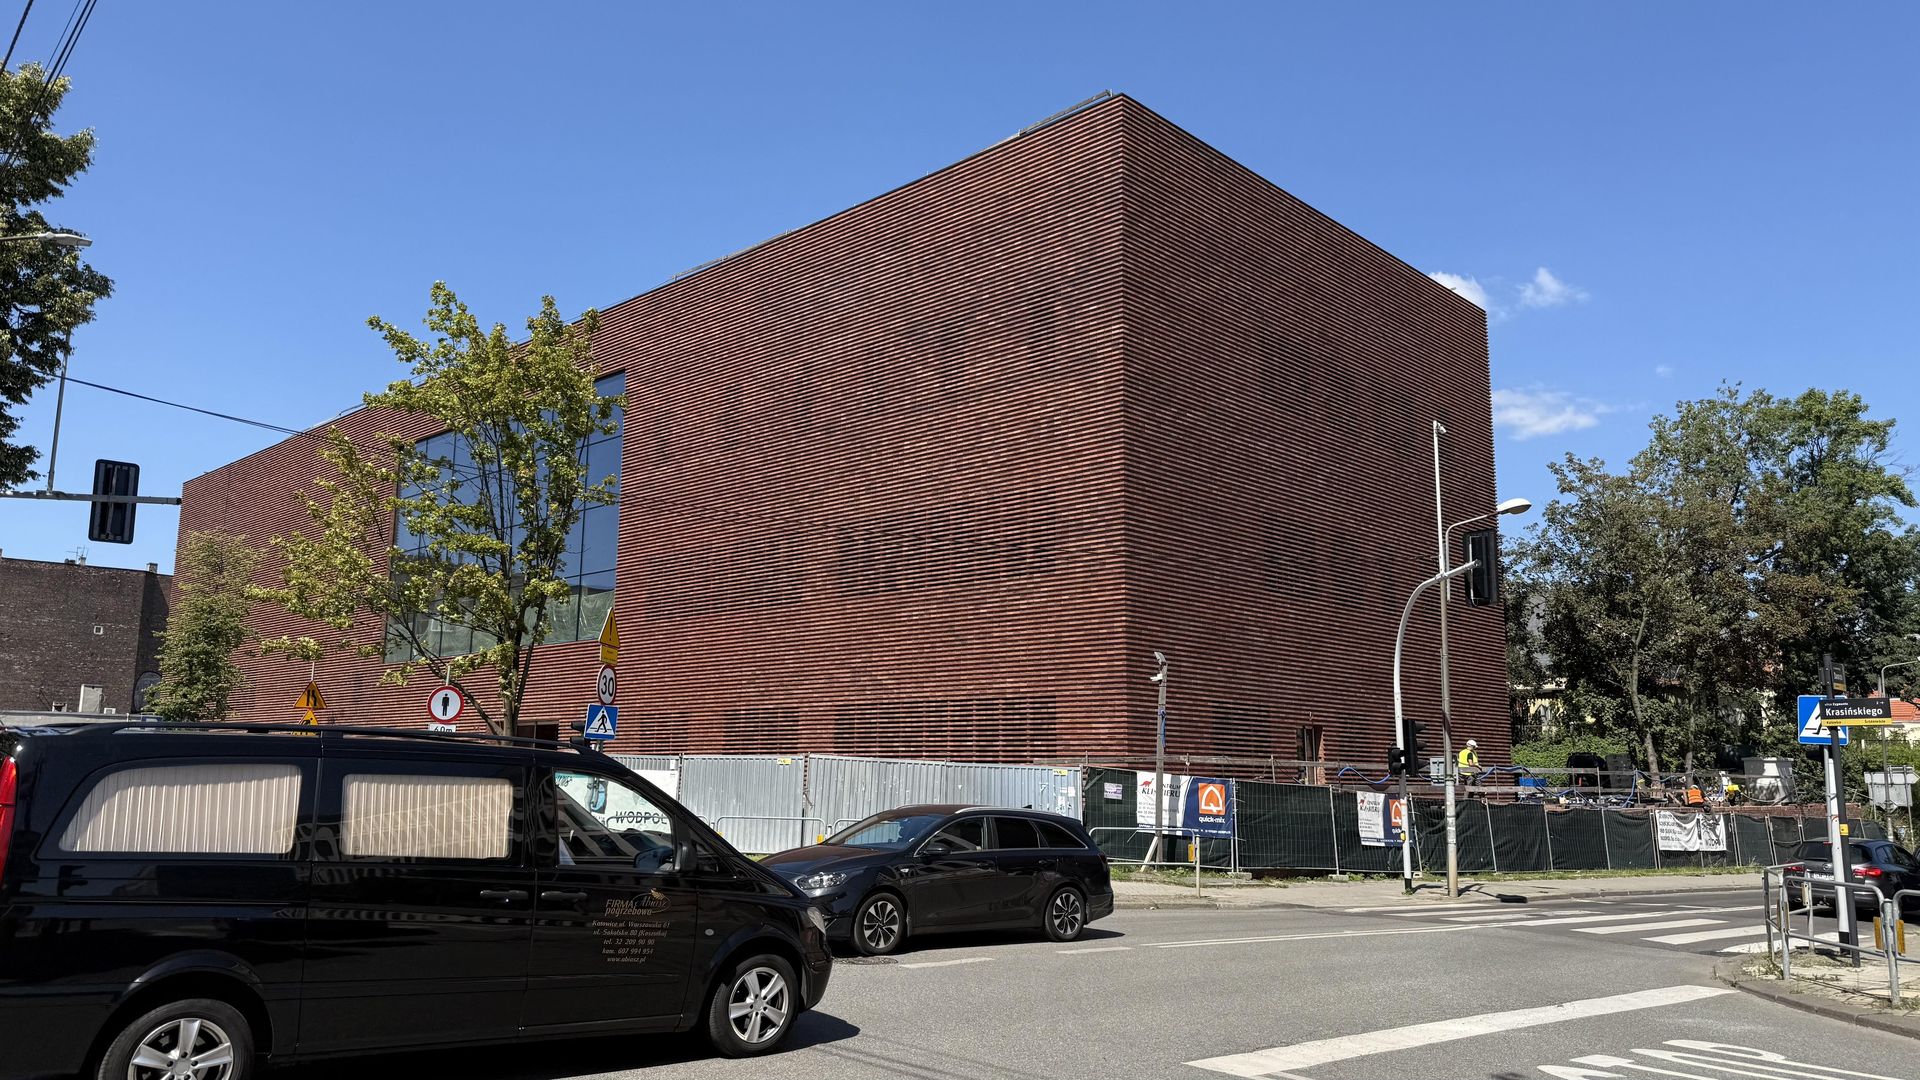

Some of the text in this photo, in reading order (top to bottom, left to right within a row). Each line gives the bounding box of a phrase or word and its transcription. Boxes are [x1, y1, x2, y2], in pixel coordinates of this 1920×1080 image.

[600, 675, 614, 697] 30
[1825, 707, 1883, 717] Krasińskiego
[1141, 787, 1180, 798] KLIIERU
[615, 810, 667, 826] WODPOL
[1198, 815, 1226, 824] quick-mix
[605, 899, 634, 909] FIRMA
[604, 906, 653, 917] pogrzebowa
